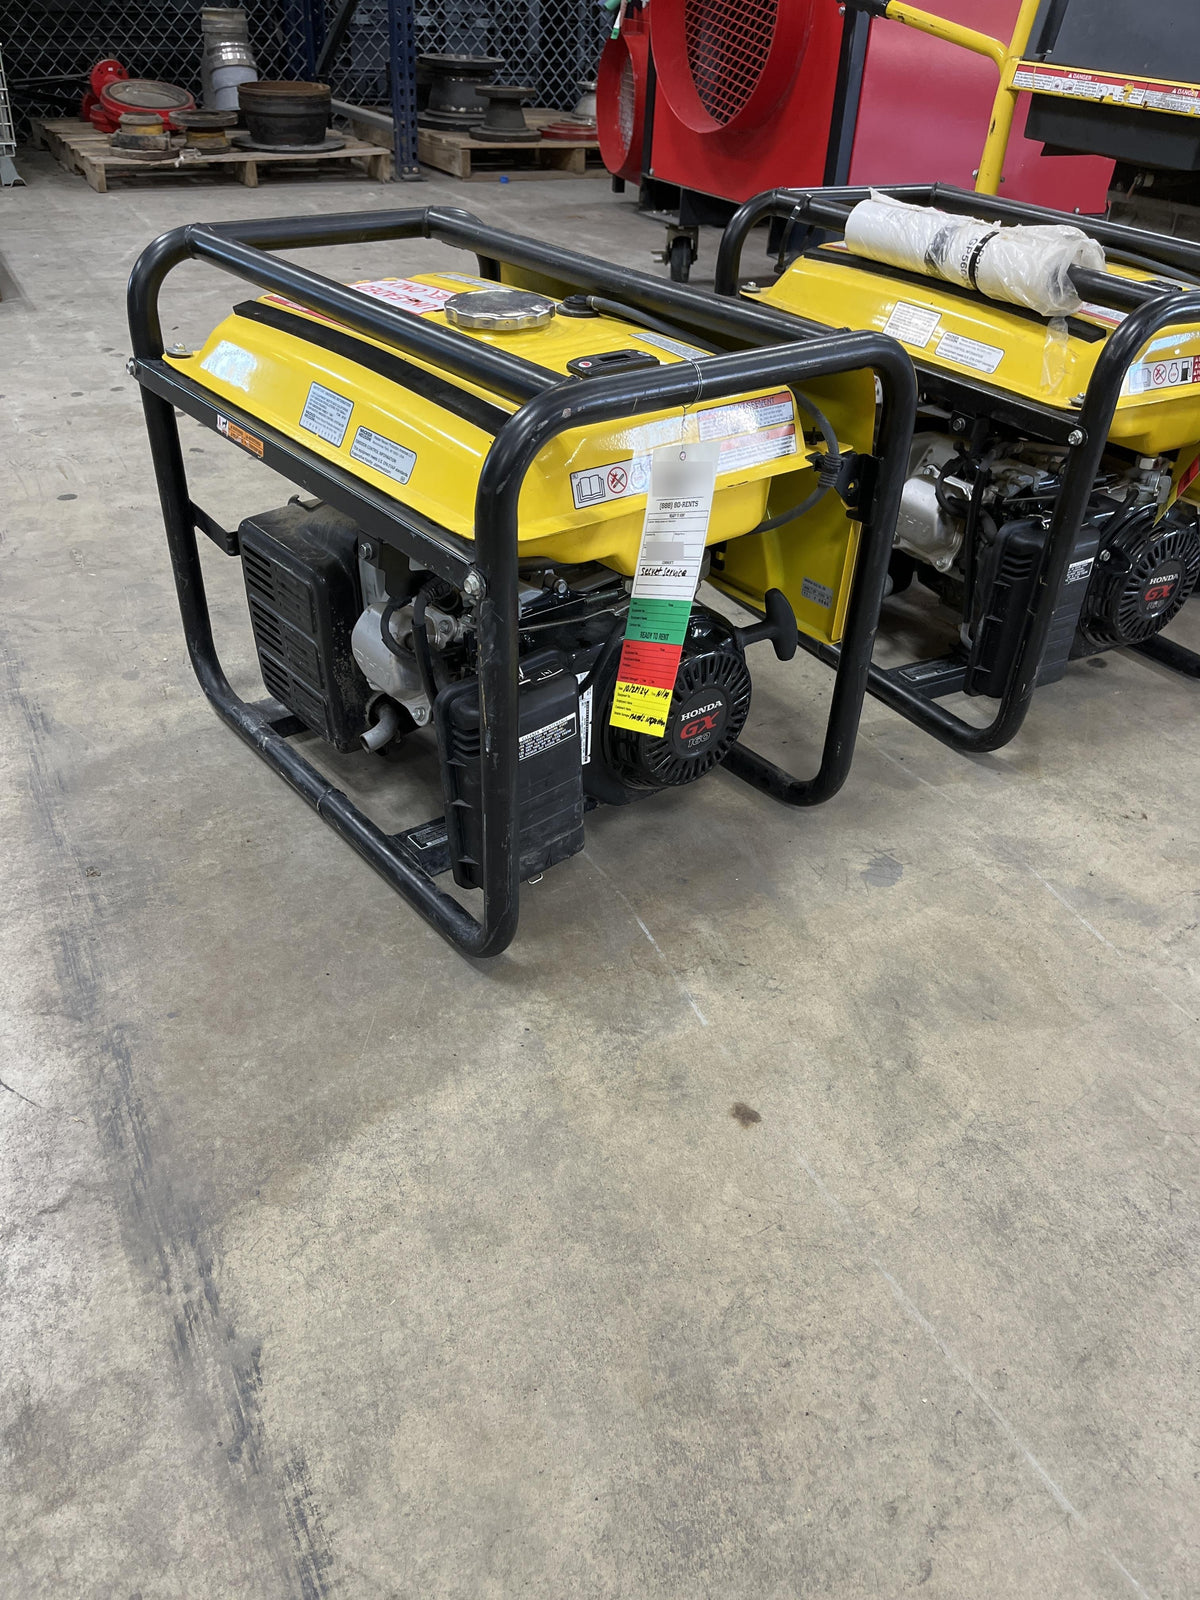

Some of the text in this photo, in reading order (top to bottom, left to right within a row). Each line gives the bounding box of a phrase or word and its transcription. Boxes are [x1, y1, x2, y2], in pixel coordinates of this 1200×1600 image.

[1073, 73, 1092, 81] DANGER
[1149, 574, 1178, 585] HONDA
[1144, 583, 1174, 601] GX
[681, 700, 723, 722] HONDA
[680, 711, 720, 739] GX
